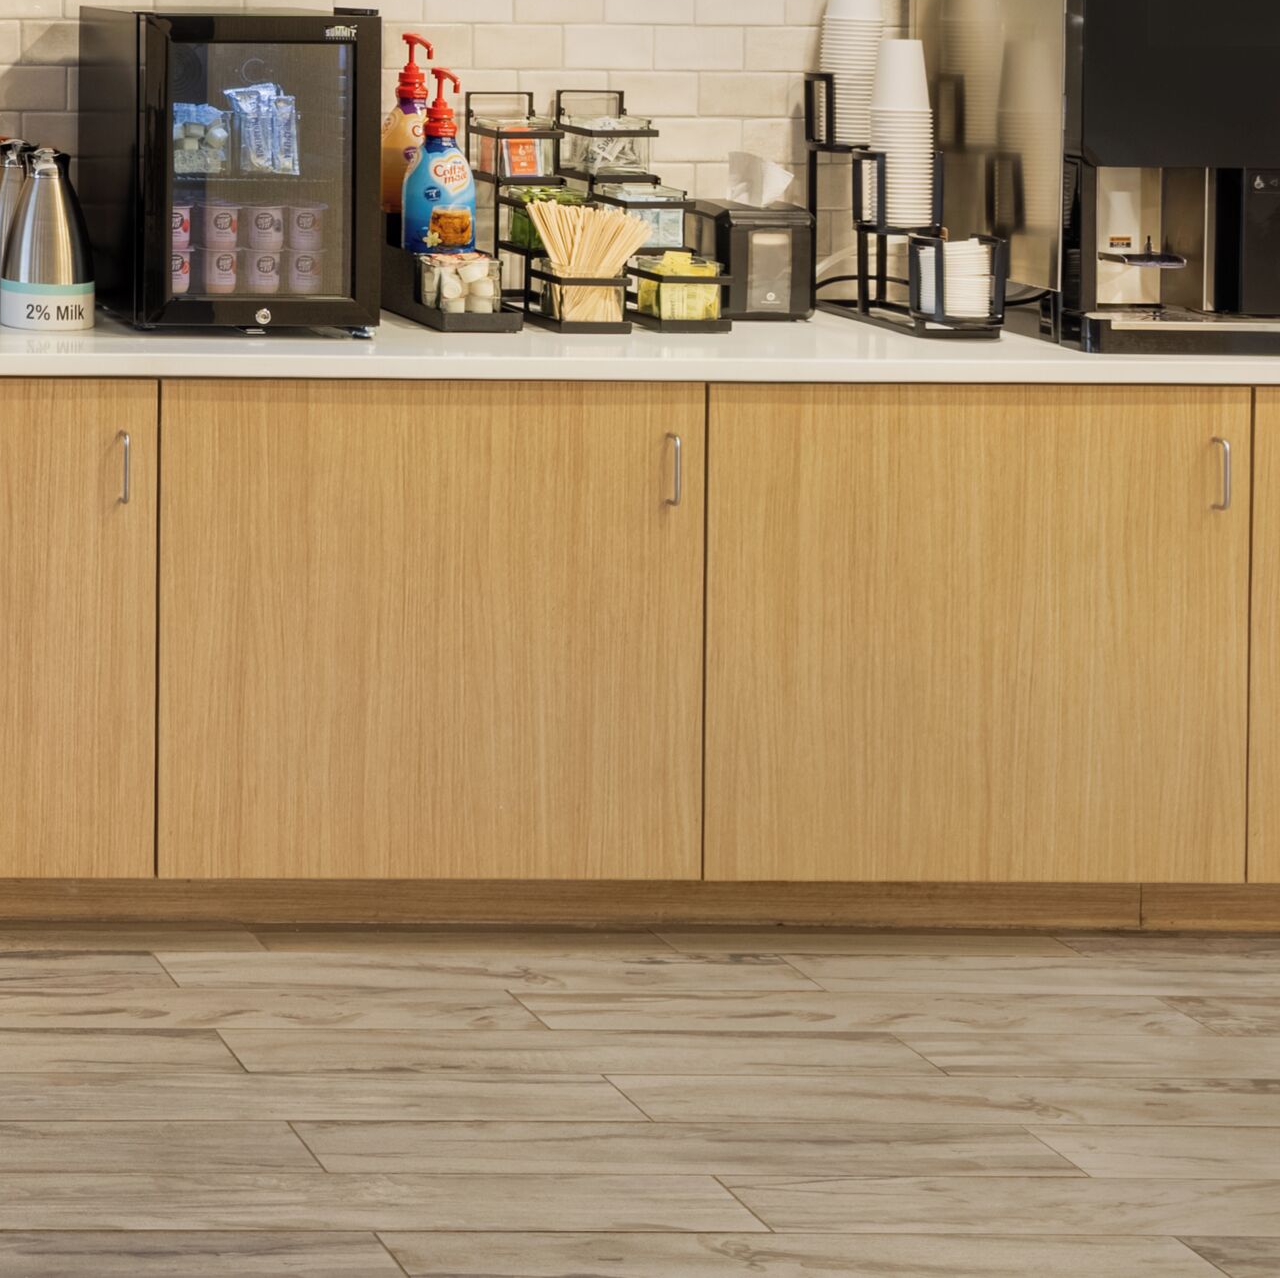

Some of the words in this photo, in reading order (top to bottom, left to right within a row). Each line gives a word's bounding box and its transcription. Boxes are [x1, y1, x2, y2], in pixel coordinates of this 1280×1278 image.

[325, 25, 357, 37] SUMMIT
[26, 304, 51, 321] 2%
[56, 304, 85, 321] Milk
